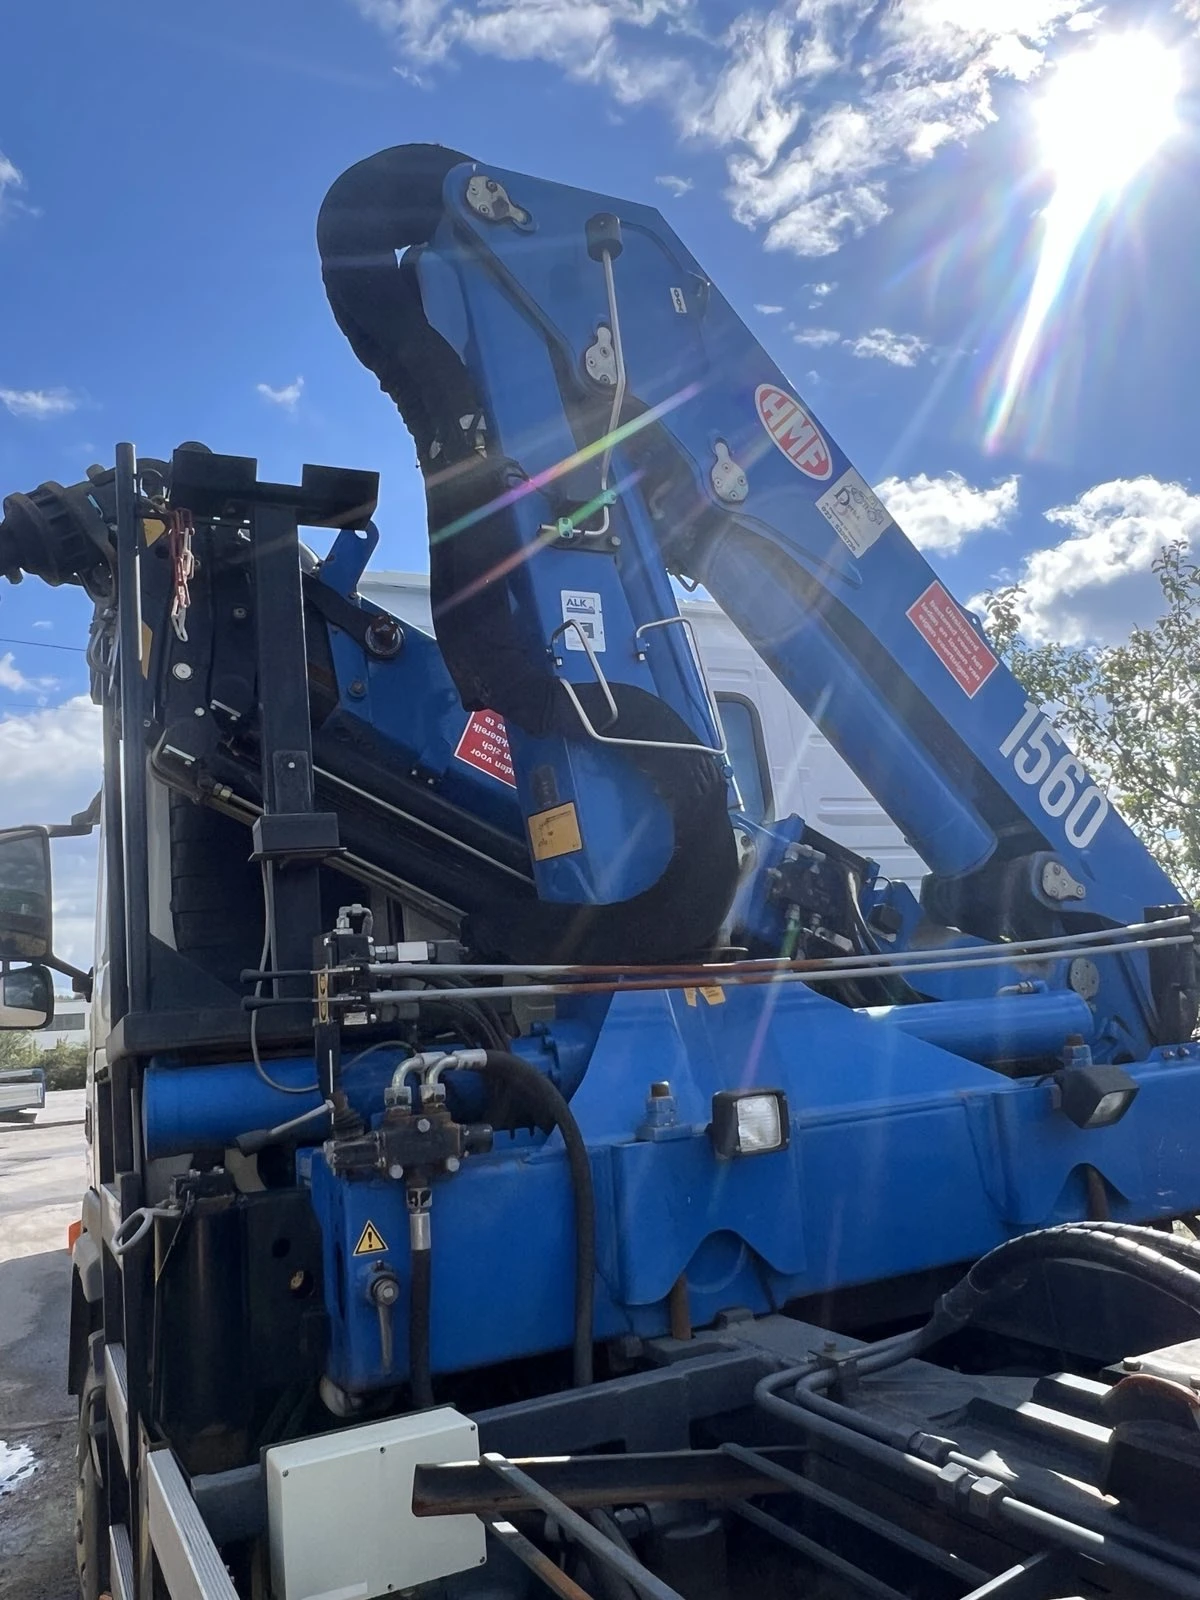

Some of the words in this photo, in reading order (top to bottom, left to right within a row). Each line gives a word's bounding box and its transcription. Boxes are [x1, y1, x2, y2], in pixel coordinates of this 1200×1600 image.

[759, 391, 828, 468] HMF
[566, 598, 587, 607] ALK
[944, 606, 980, 652] Uitsluitend
[484, 716, 495, 726] te
[472, 722, 509, 748] kbereik
[470, 748, 492, 764] voor
[481, 740, 502, 755] zich
[999, 700, 1108, 848] 1560
